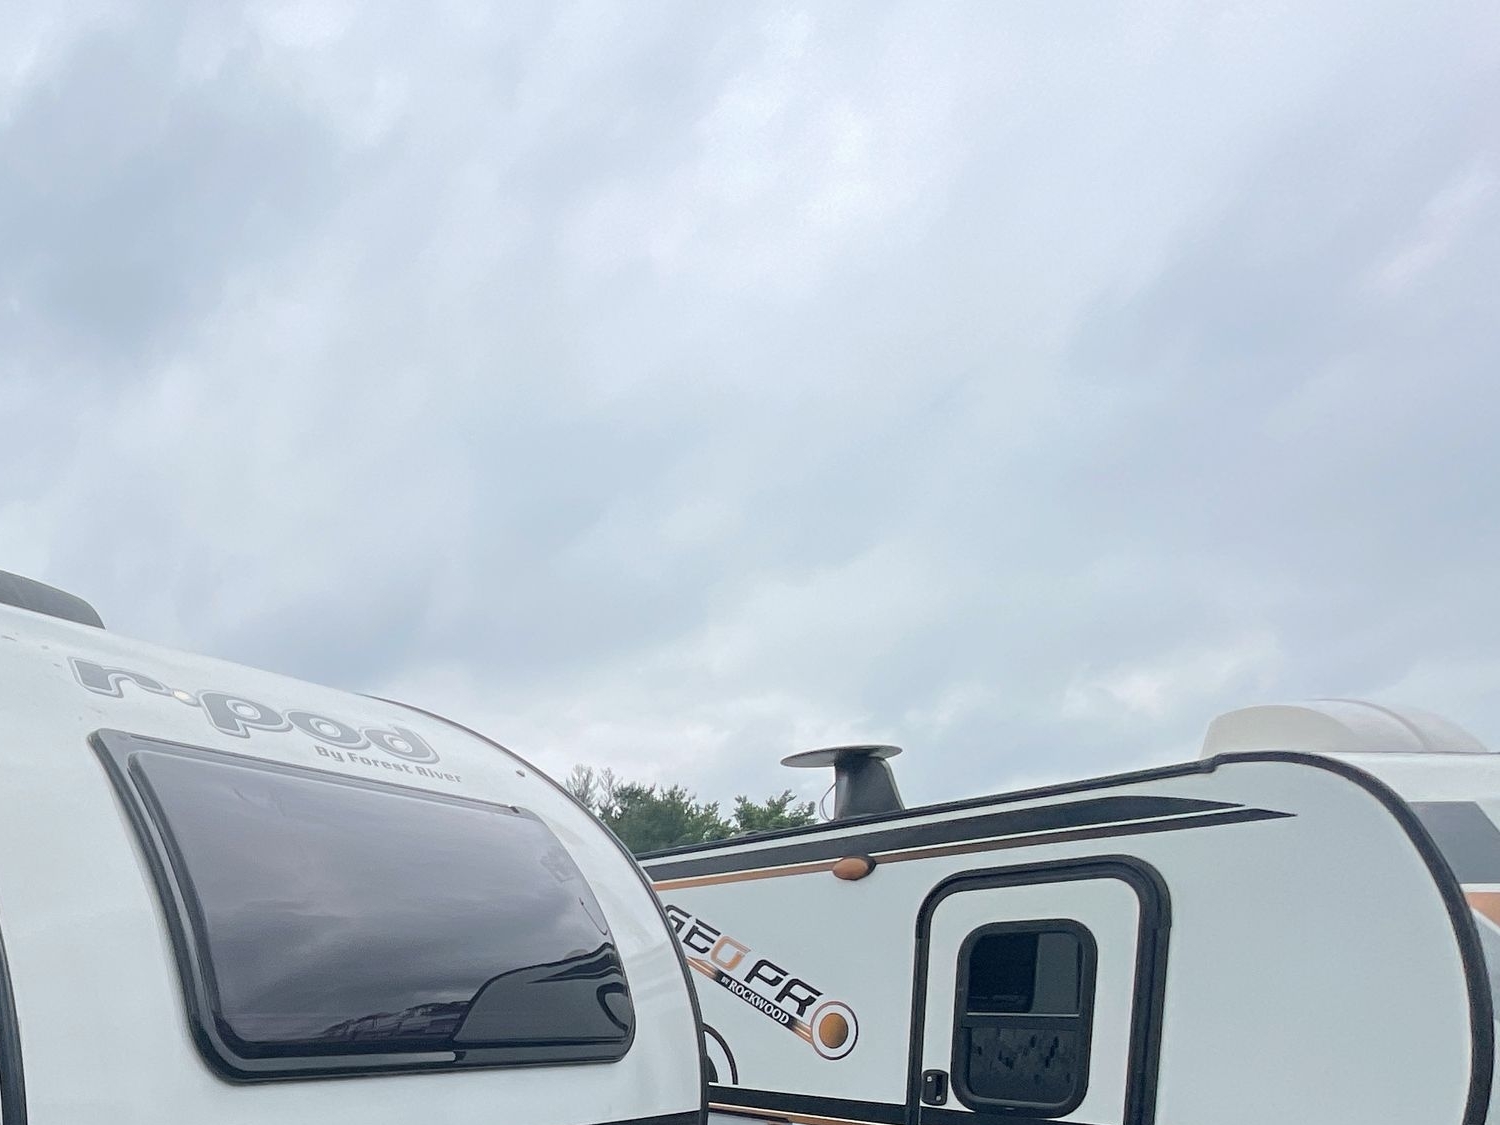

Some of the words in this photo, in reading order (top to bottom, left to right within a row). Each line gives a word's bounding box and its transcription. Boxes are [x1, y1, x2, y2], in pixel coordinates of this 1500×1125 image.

[314, 745, 345, 763] By
[349, 752, 413, 774] Forest
[415, 765, 462, 783] River
[720, 974, 731, 986] BY
[728, 979, 791, 1026] ROCKWOOD
